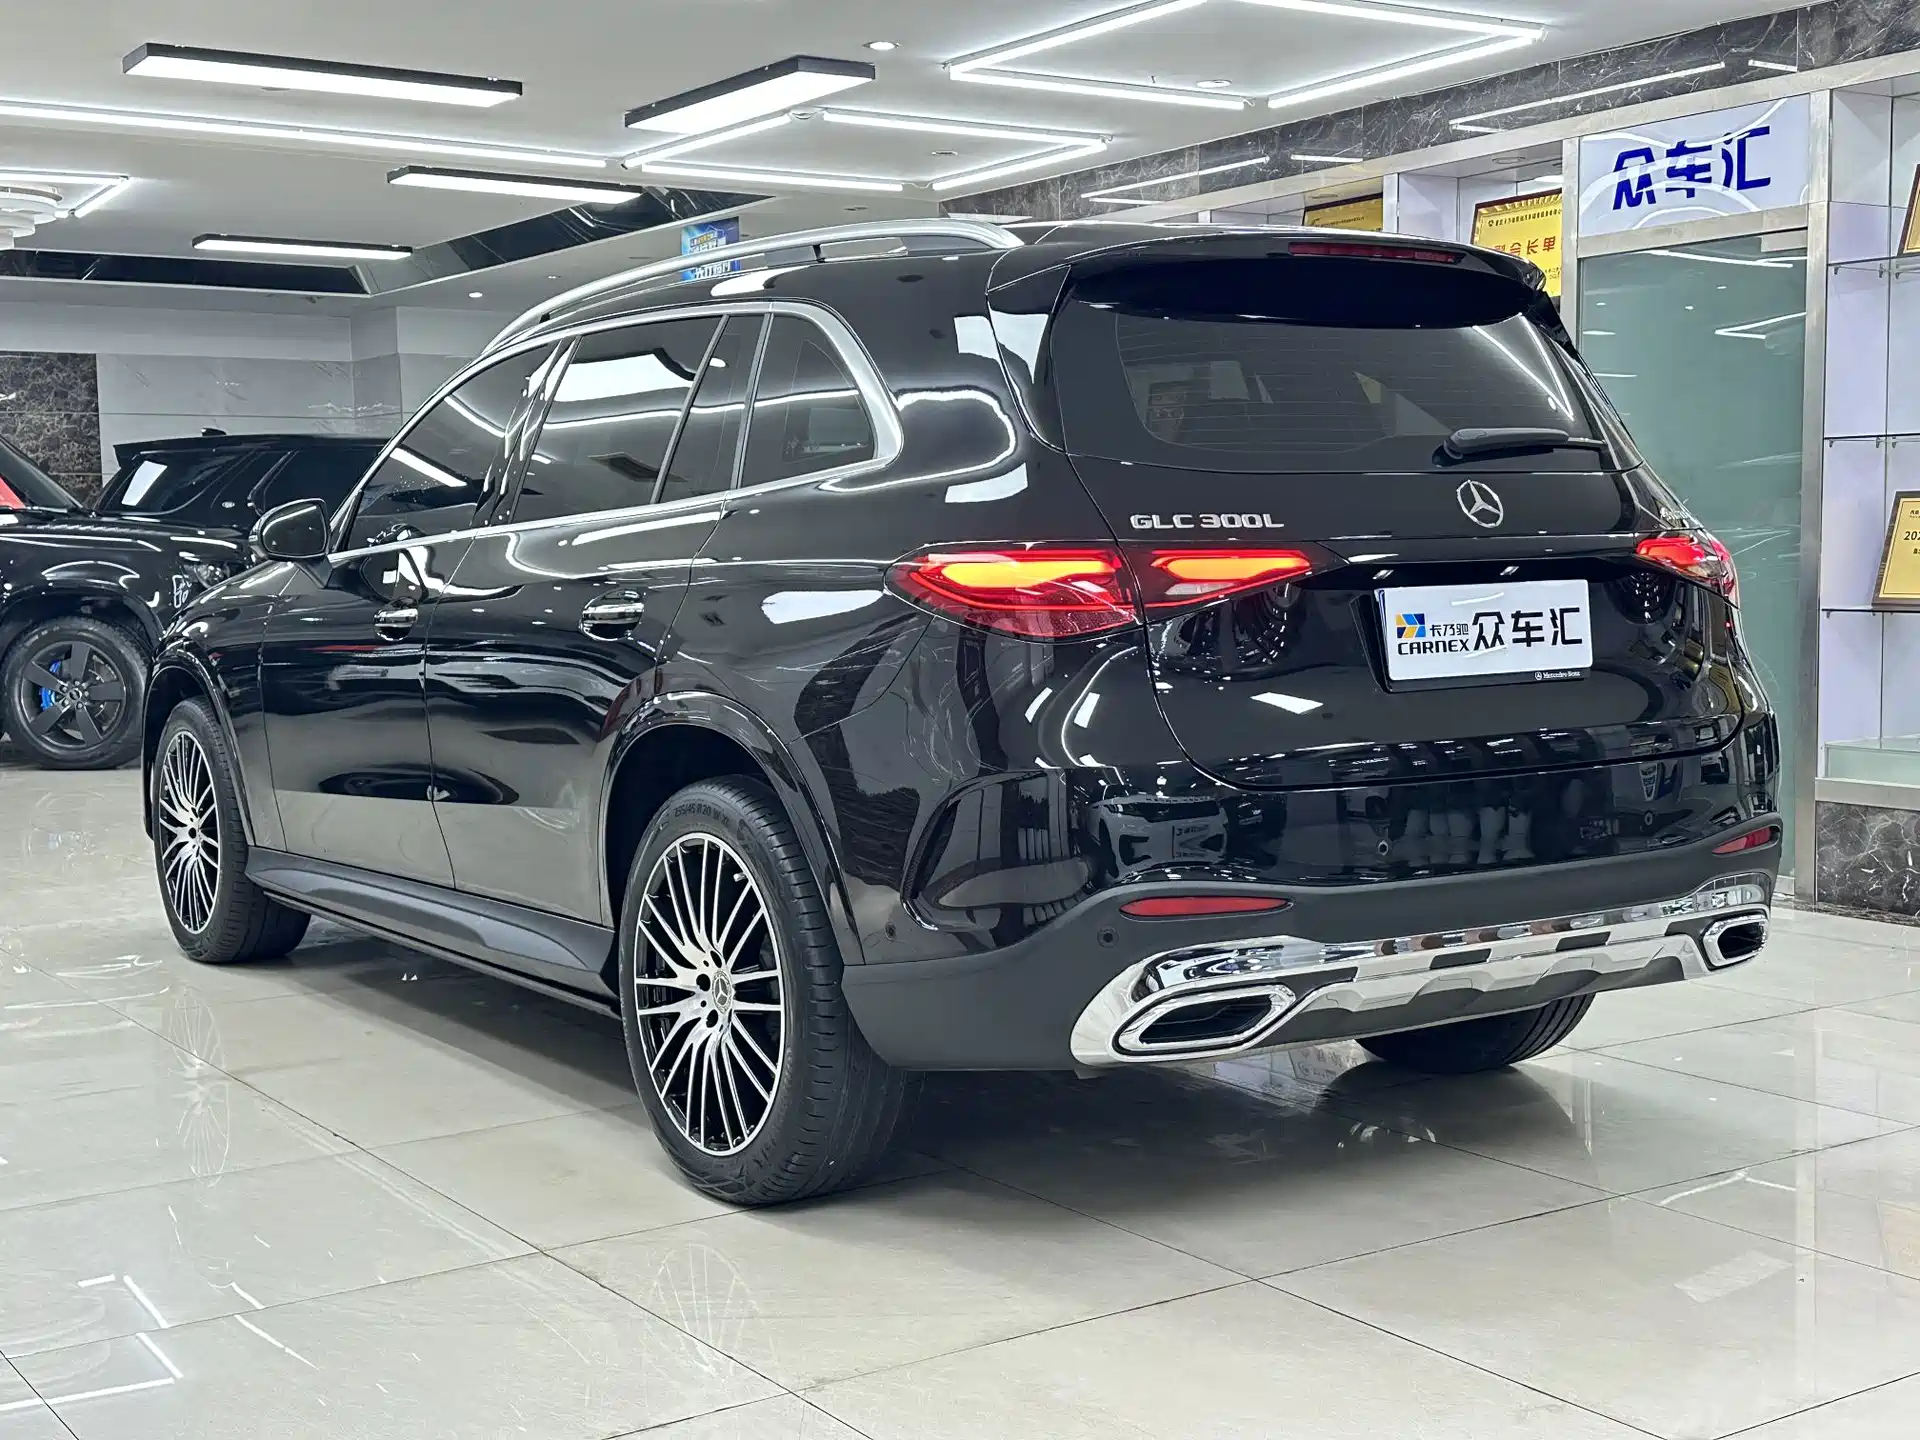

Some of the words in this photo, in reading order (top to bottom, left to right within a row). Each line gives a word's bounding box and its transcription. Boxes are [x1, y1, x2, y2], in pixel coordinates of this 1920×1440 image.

[1612, 126, 1771, 210] 众车汇
[1129, 514, 1195, 529] GLC
[1199, 513, 1285, 529] 300L
[1472, 607, 1583, 651] 众车汇
[1398, 638, 1470, 655] CARNEX
